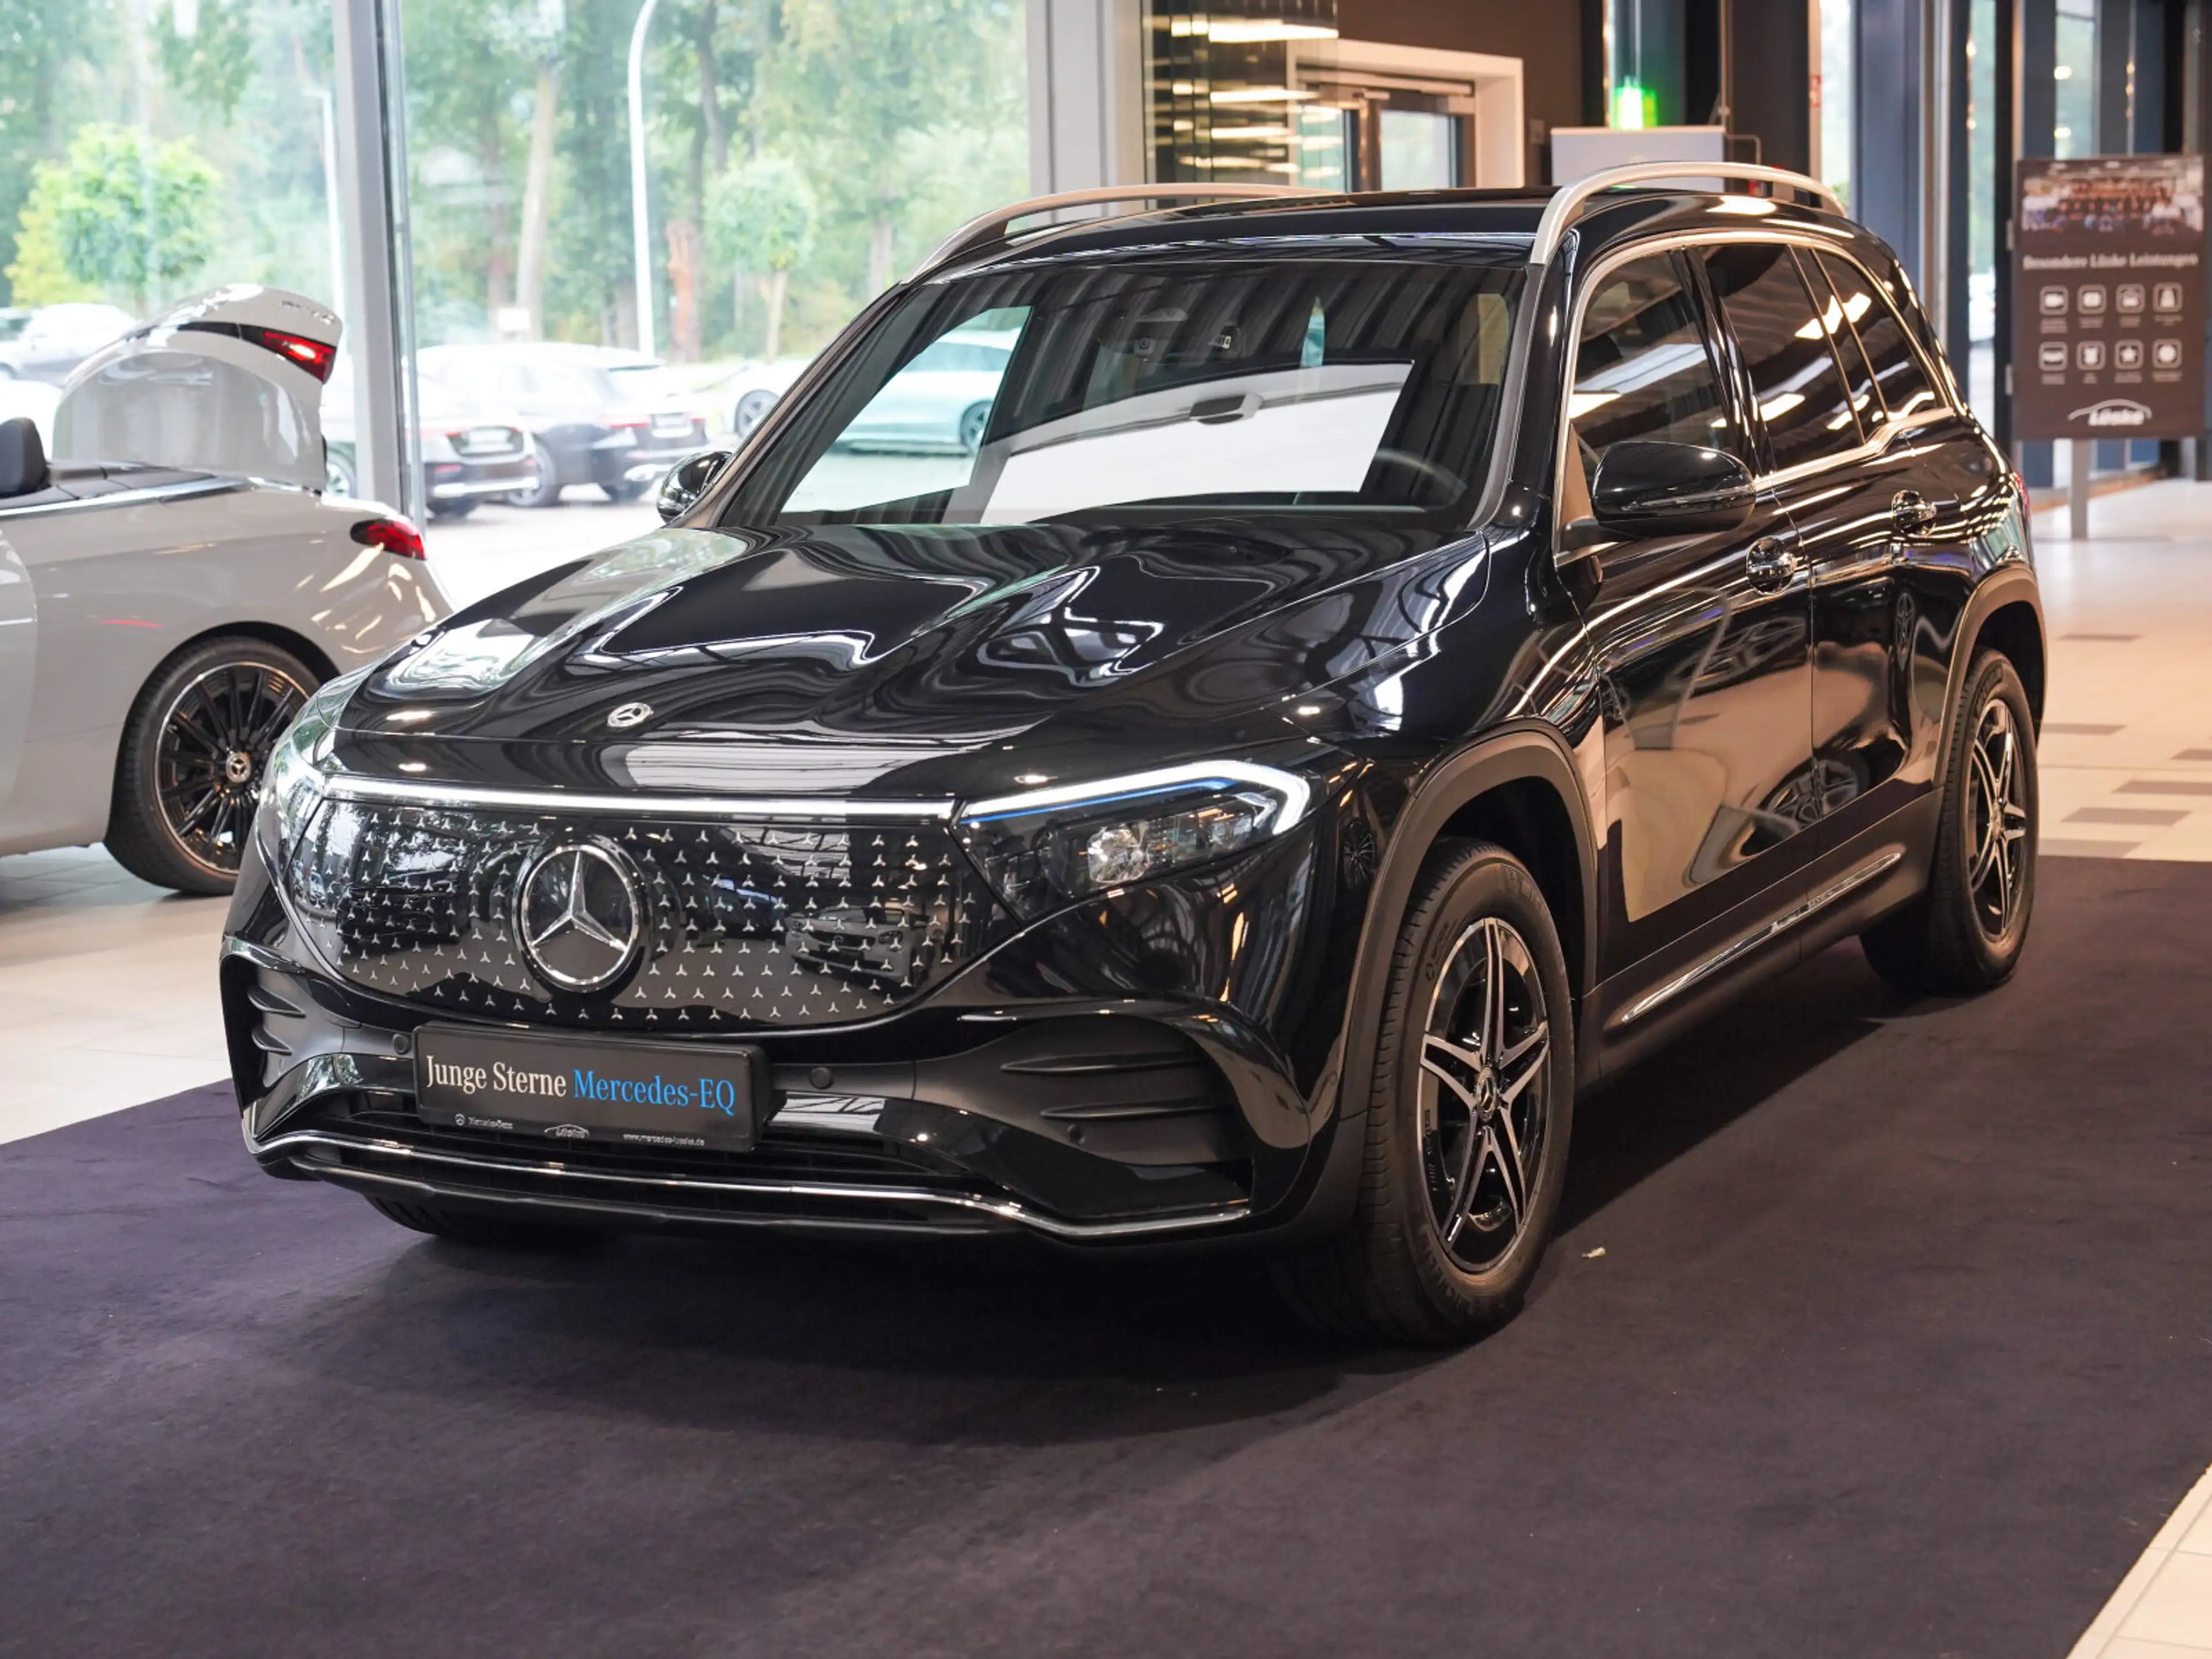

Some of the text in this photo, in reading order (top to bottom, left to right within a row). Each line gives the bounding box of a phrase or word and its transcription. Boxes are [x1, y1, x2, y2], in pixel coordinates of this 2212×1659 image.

[426, 1055, 735, 1116] Junge Sterne Mercedes-EQ
